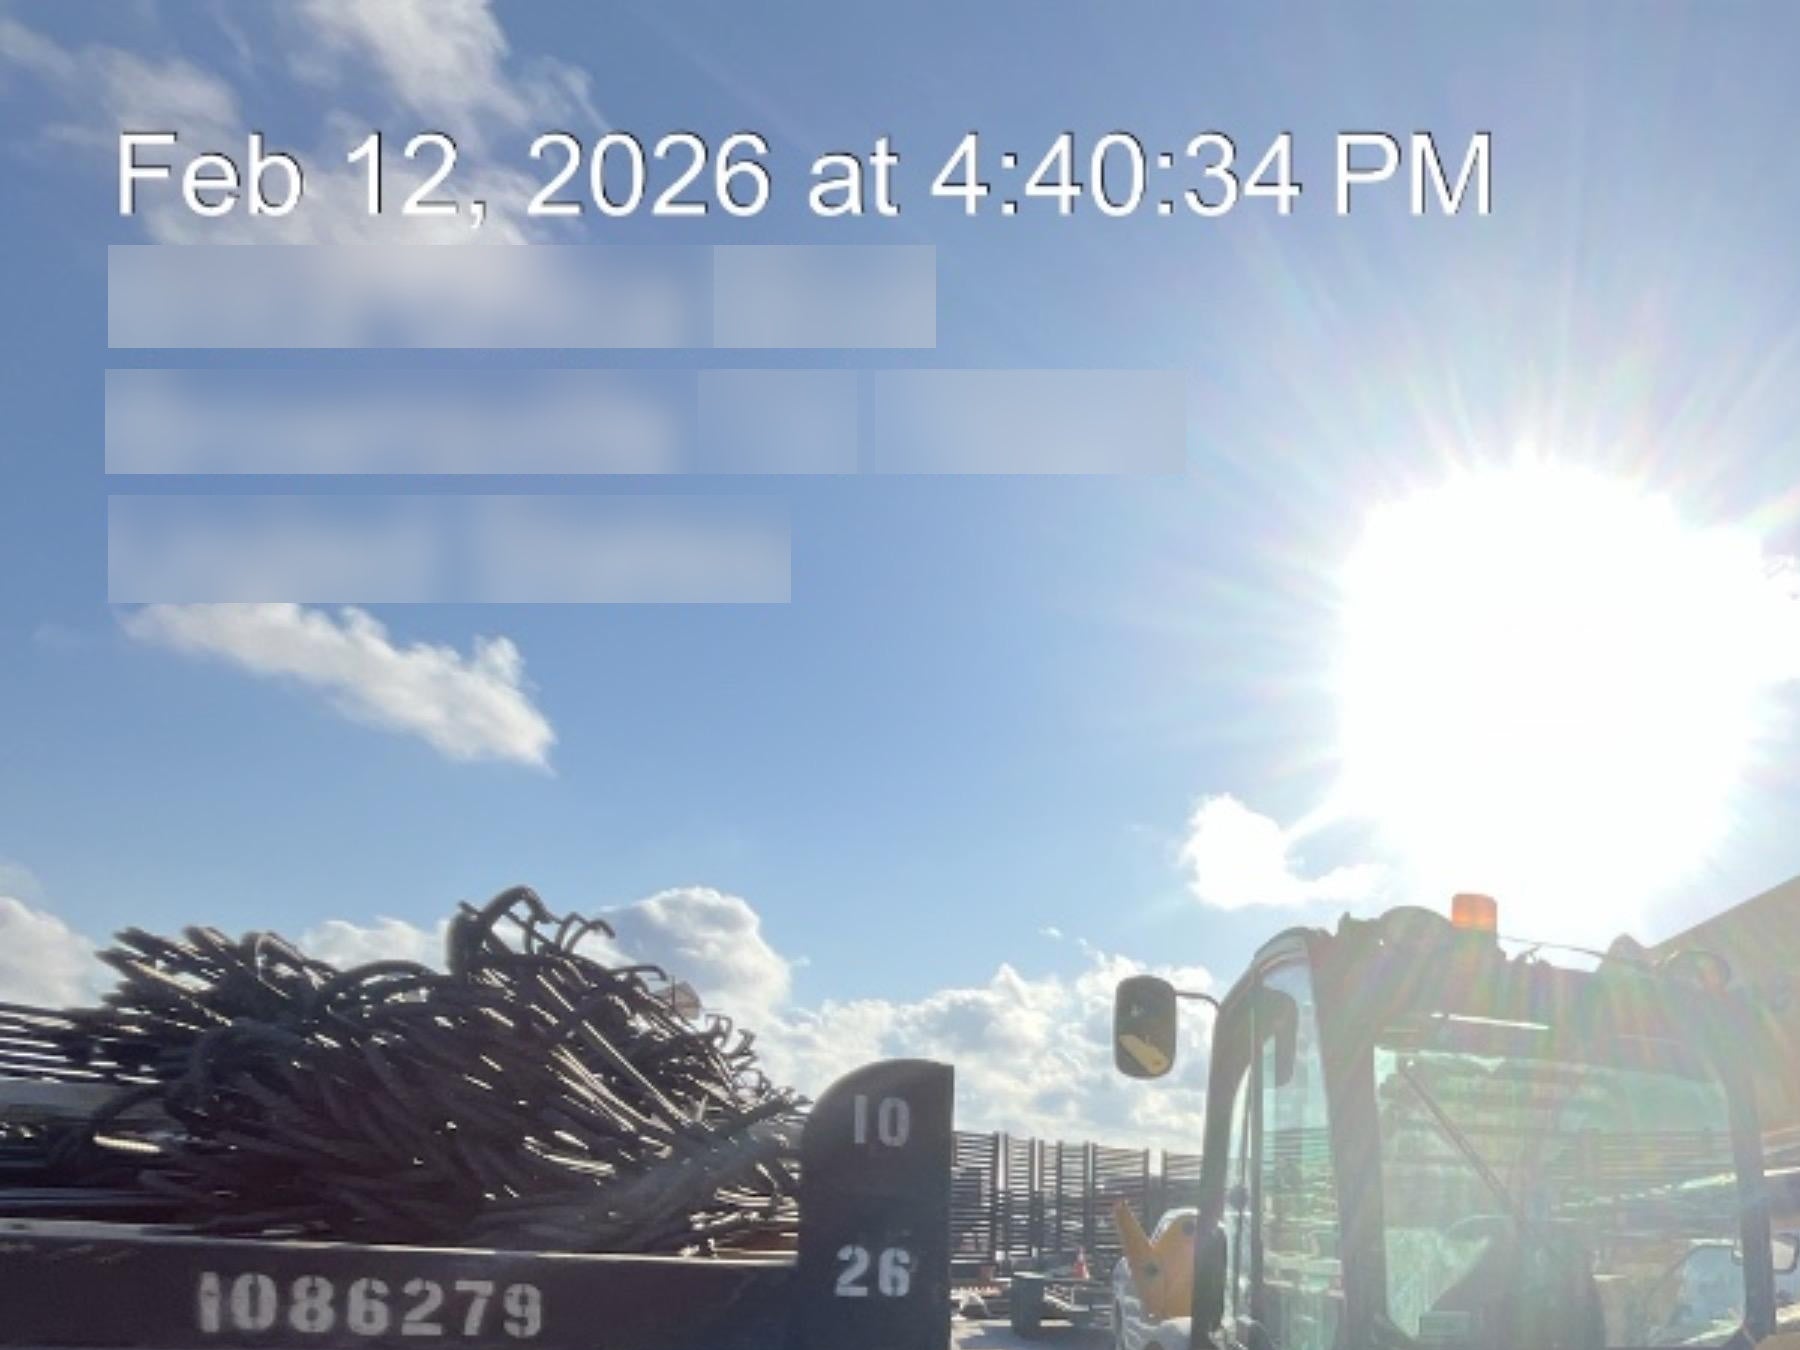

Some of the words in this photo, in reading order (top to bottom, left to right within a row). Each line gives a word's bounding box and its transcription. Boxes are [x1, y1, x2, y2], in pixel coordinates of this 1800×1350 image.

[853, 1094, 910, 1147] 10
[835, 1245, 910, 1297] 26
[198, 1271, 543, 1338] 1086279
